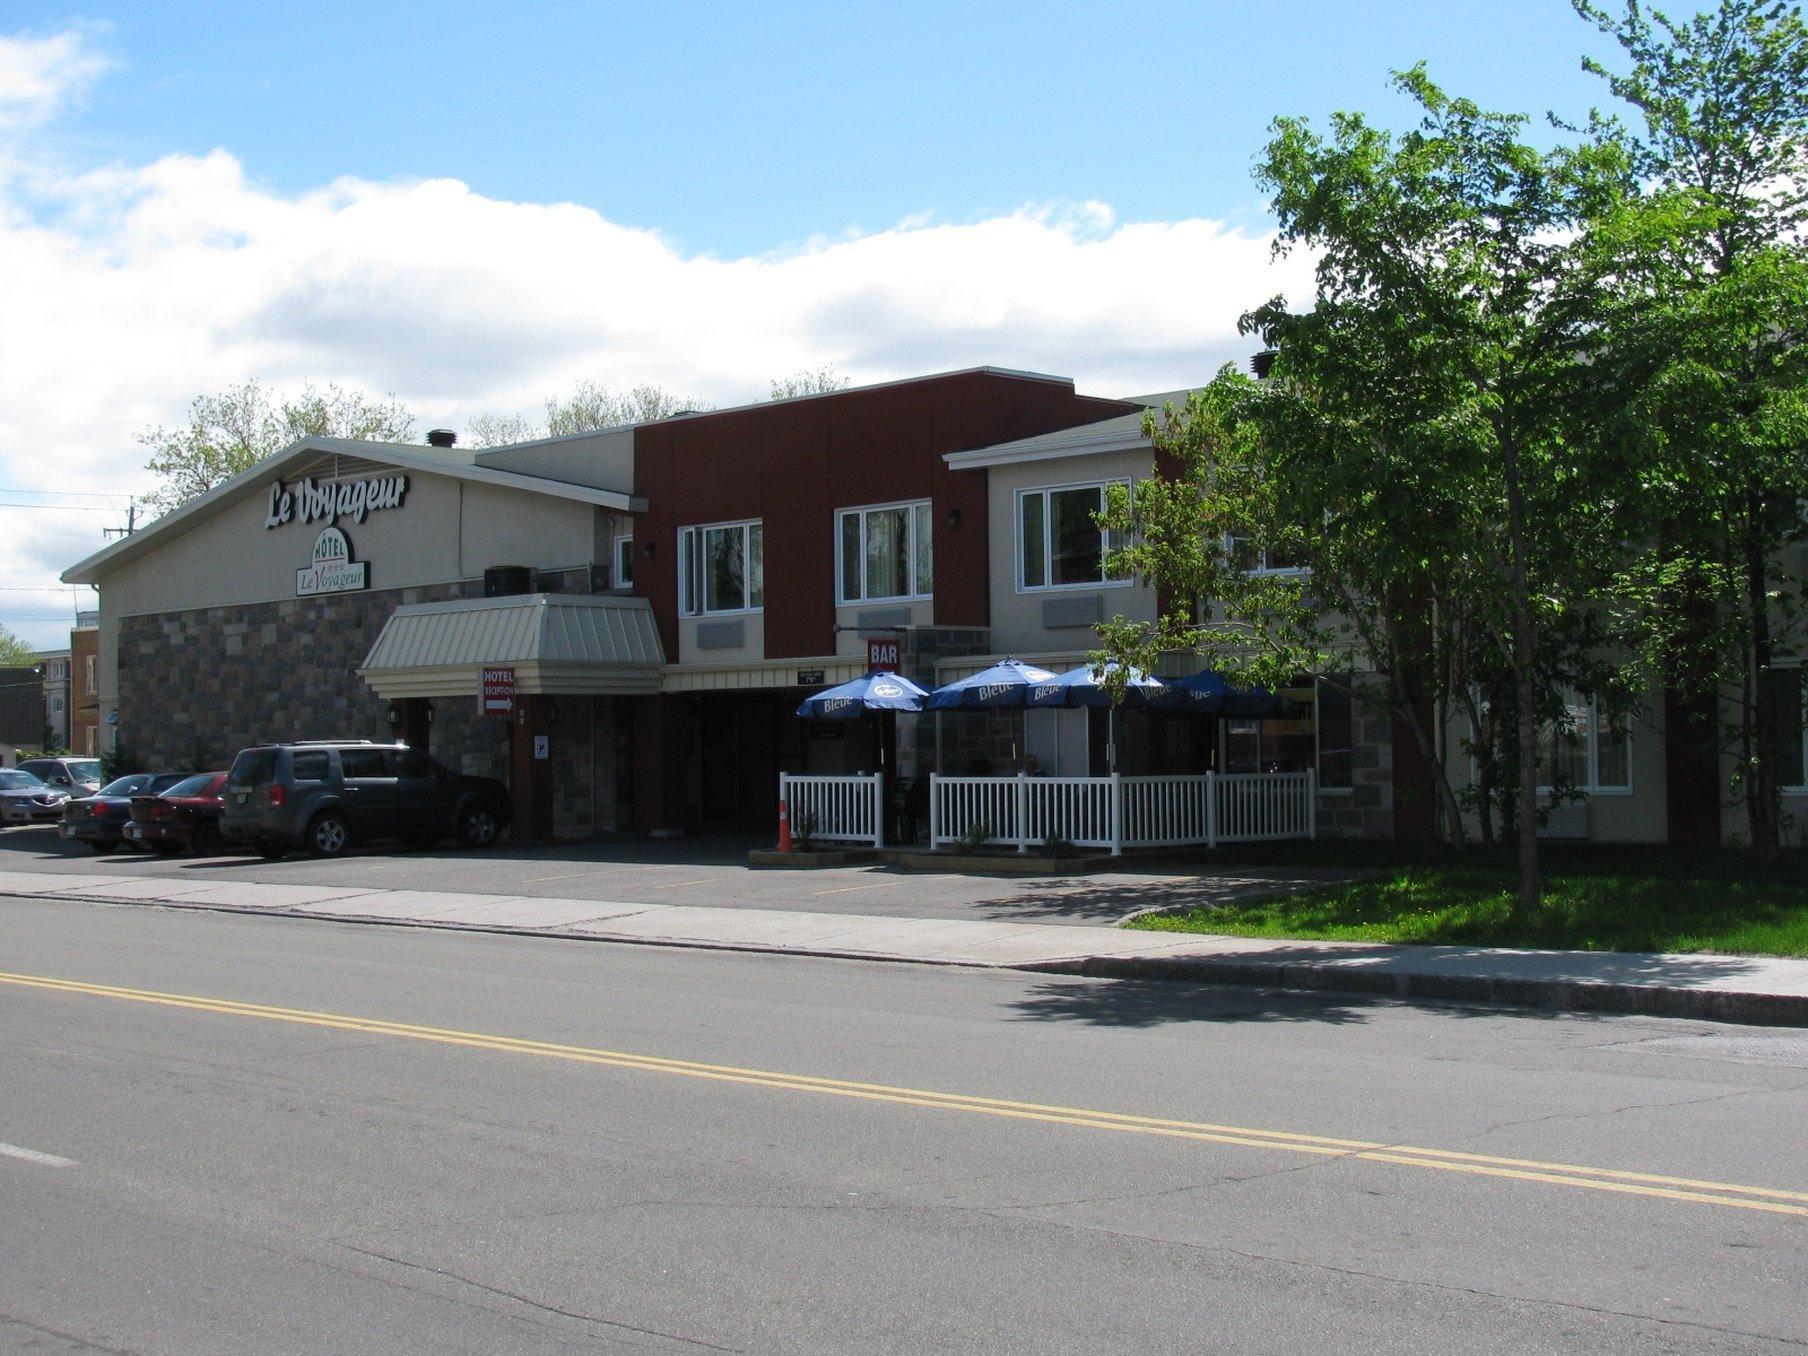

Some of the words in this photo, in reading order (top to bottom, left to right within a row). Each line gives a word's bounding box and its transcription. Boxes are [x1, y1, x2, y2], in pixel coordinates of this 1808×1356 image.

[264, 480, 293, 529] Le
[295, 476, 409, 525] Voyageur
[301, 575, 313, 590] Le
[314, 566, 363, 590] Voyageur
[871, 644, 897, 663] BAR
[484, 671, 514, 682] HOTEL
[979, 683, 1014, 701] Bleue
[824, 696, 854, 713] Bleue
